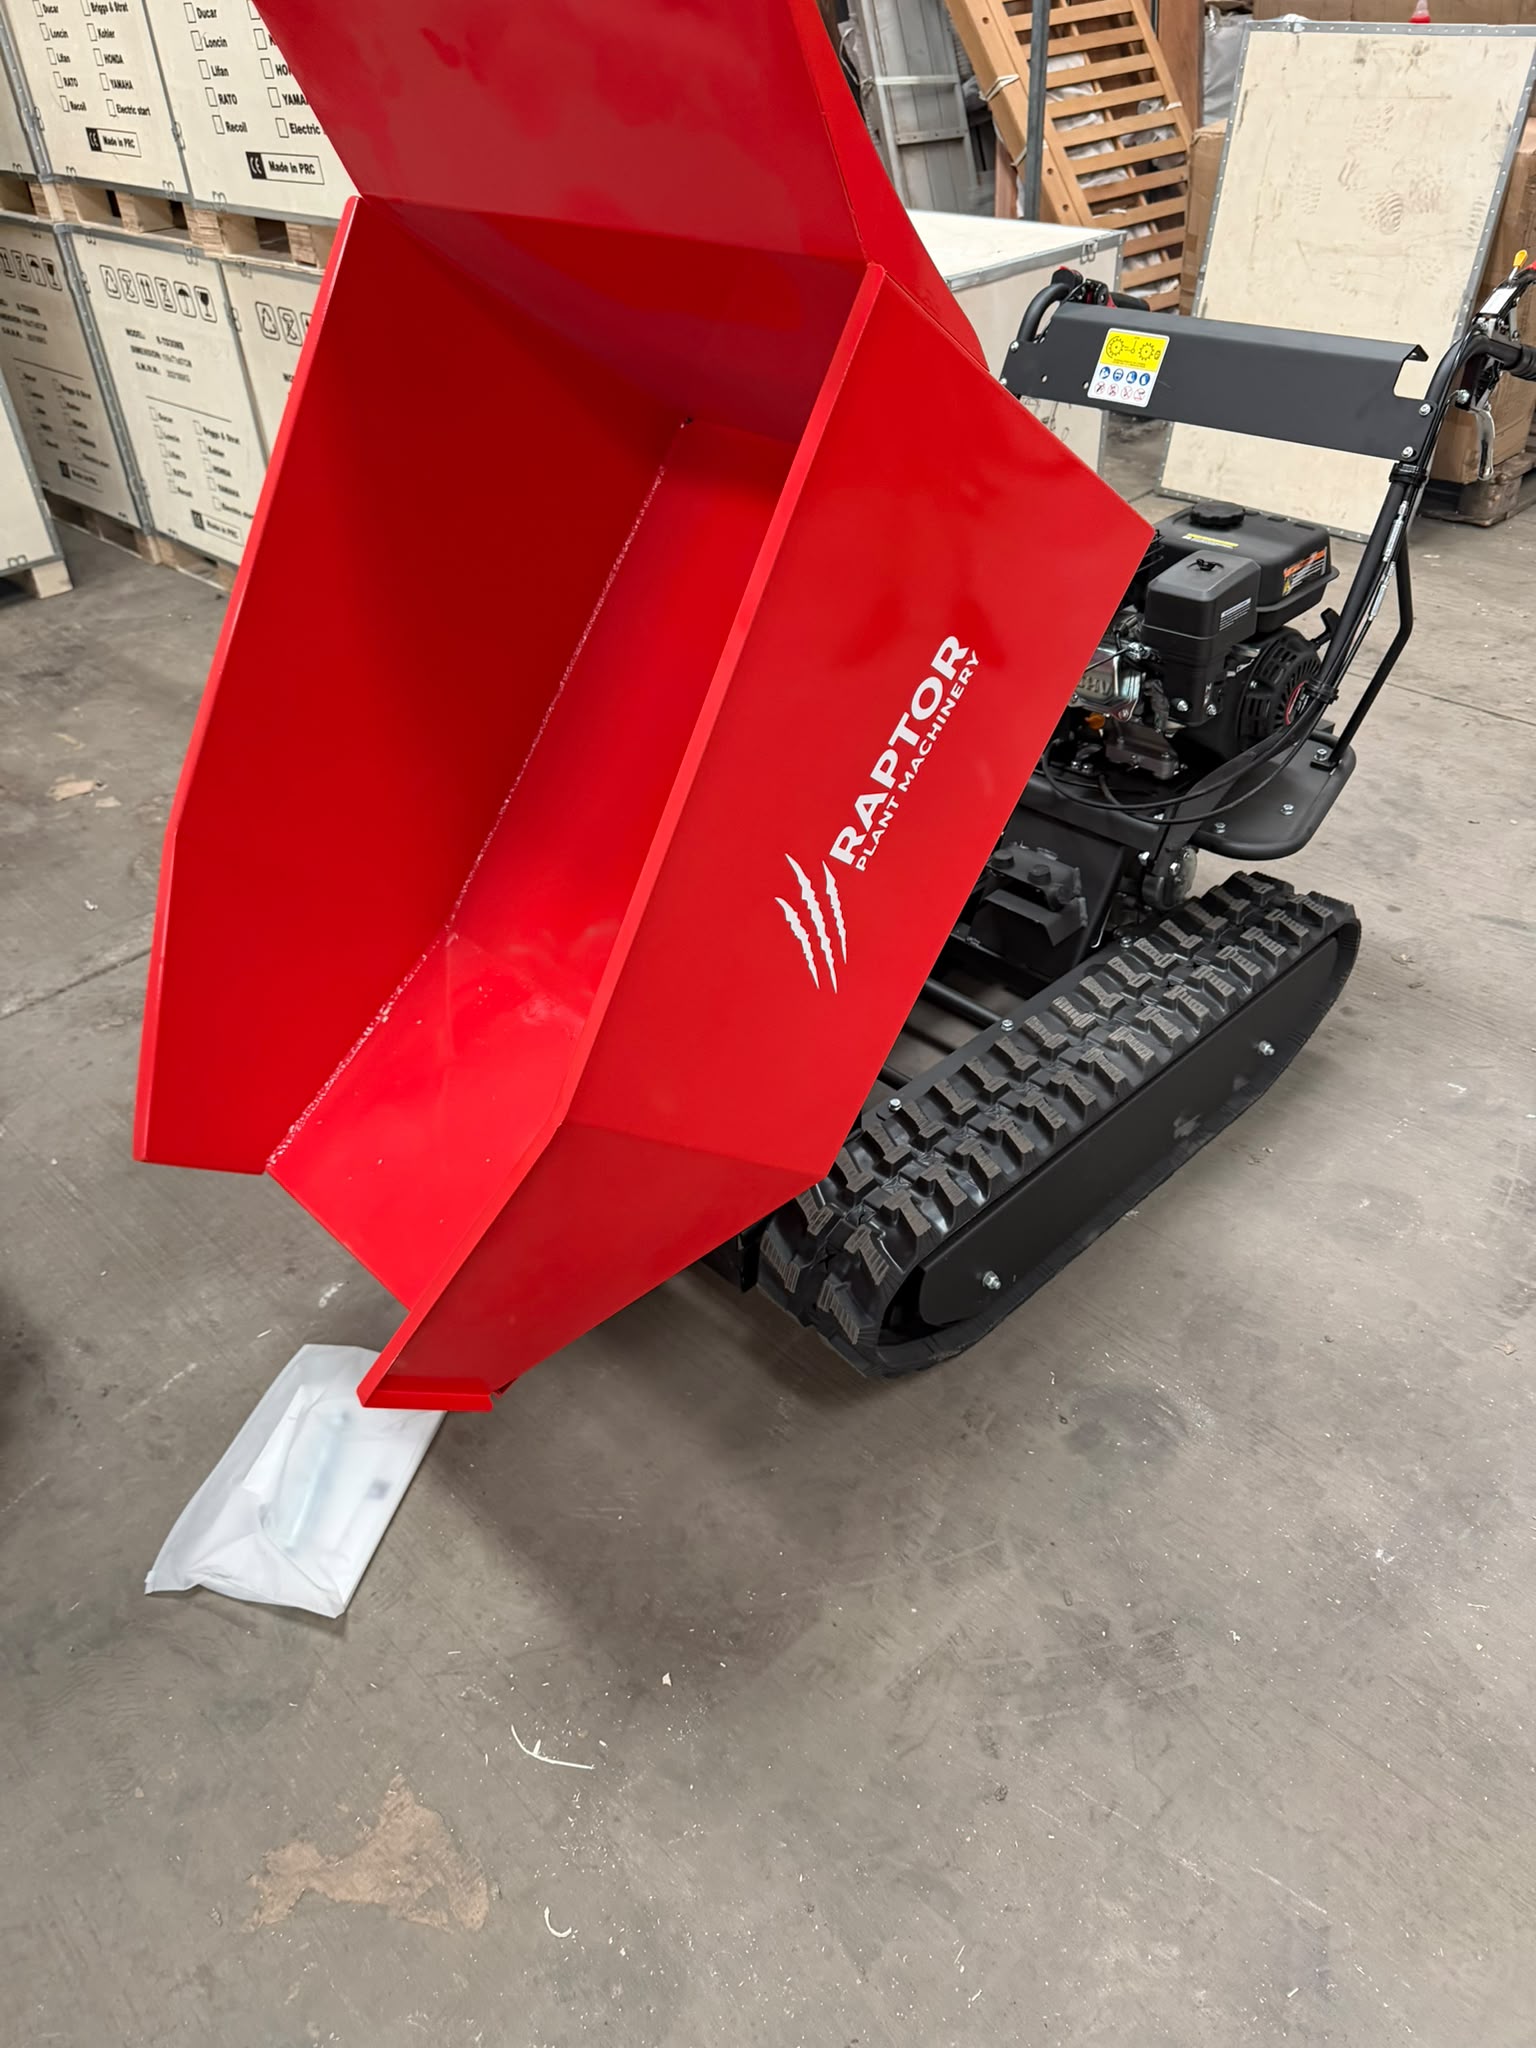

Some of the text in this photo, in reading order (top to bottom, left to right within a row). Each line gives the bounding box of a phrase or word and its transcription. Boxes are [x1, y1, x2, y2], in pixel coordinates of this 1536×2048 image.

[42, 4, 59, 14] Ducar
[91, 2, 108, 15] Briggs
[114, 2, 129, 12] Strat
[196, 8, 217, 20] Ducar
[50, 28, 69, 38] Loncin
[97, 28, 116, 38] Kohler
[203, 36, 228, 48] Loncin
[56, 53, 71, 64] Lifan
[104, 54, 124, 64] HONDA
[210, 65, 230, 77] Lifan
[63, 77, 78, 88] RATO
[110, 80, 134, 90] YAMAHA
[218, 94, 238, 106] RATO
[282, 94, 310, 106] YAMA
[70, 101, 87, 112] Recoil
[116, 104, 137, 115] Electric
[225, 120, 248, 133] Recoil
[289, 122, 321, 135] Electric
[102, 136, 118, 146] Made
[124, 138, 136, 149] PRC
[268, 160, 316, 175] Made in PRC
[829, 635, 970, 865] RAPTOR
[855, 650, 979, 873] PLANT MACHINERY
